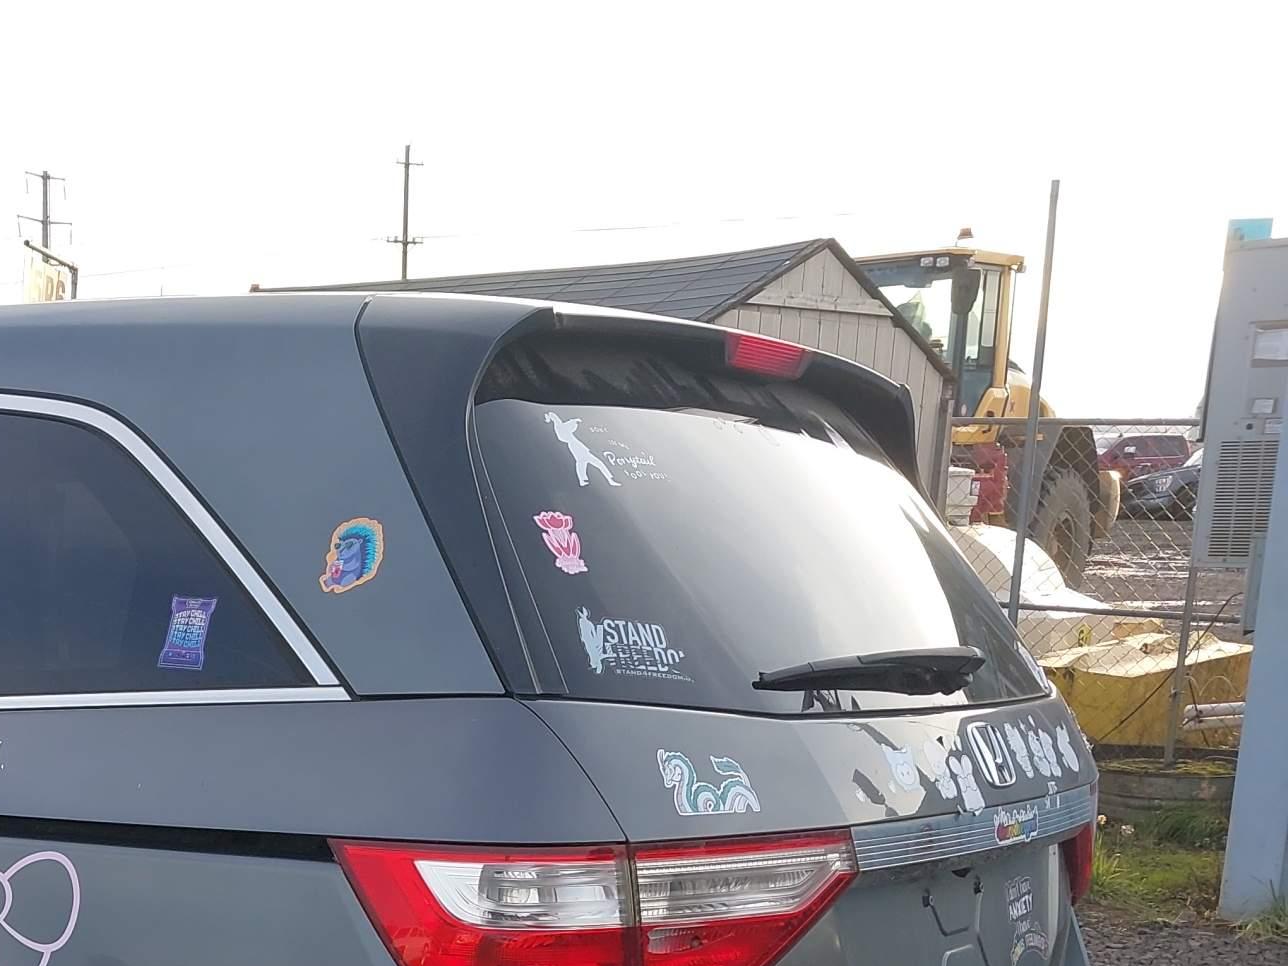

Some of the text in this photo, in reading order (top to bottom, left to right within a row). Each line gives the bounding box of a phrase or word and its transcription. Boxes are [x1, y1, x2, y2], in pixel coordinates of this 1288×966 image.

[603, 451, 656, 468] Ponytail
[603, 619, 667, 648] STAND
[1009, 893, 1033, 920] ANXIETY
